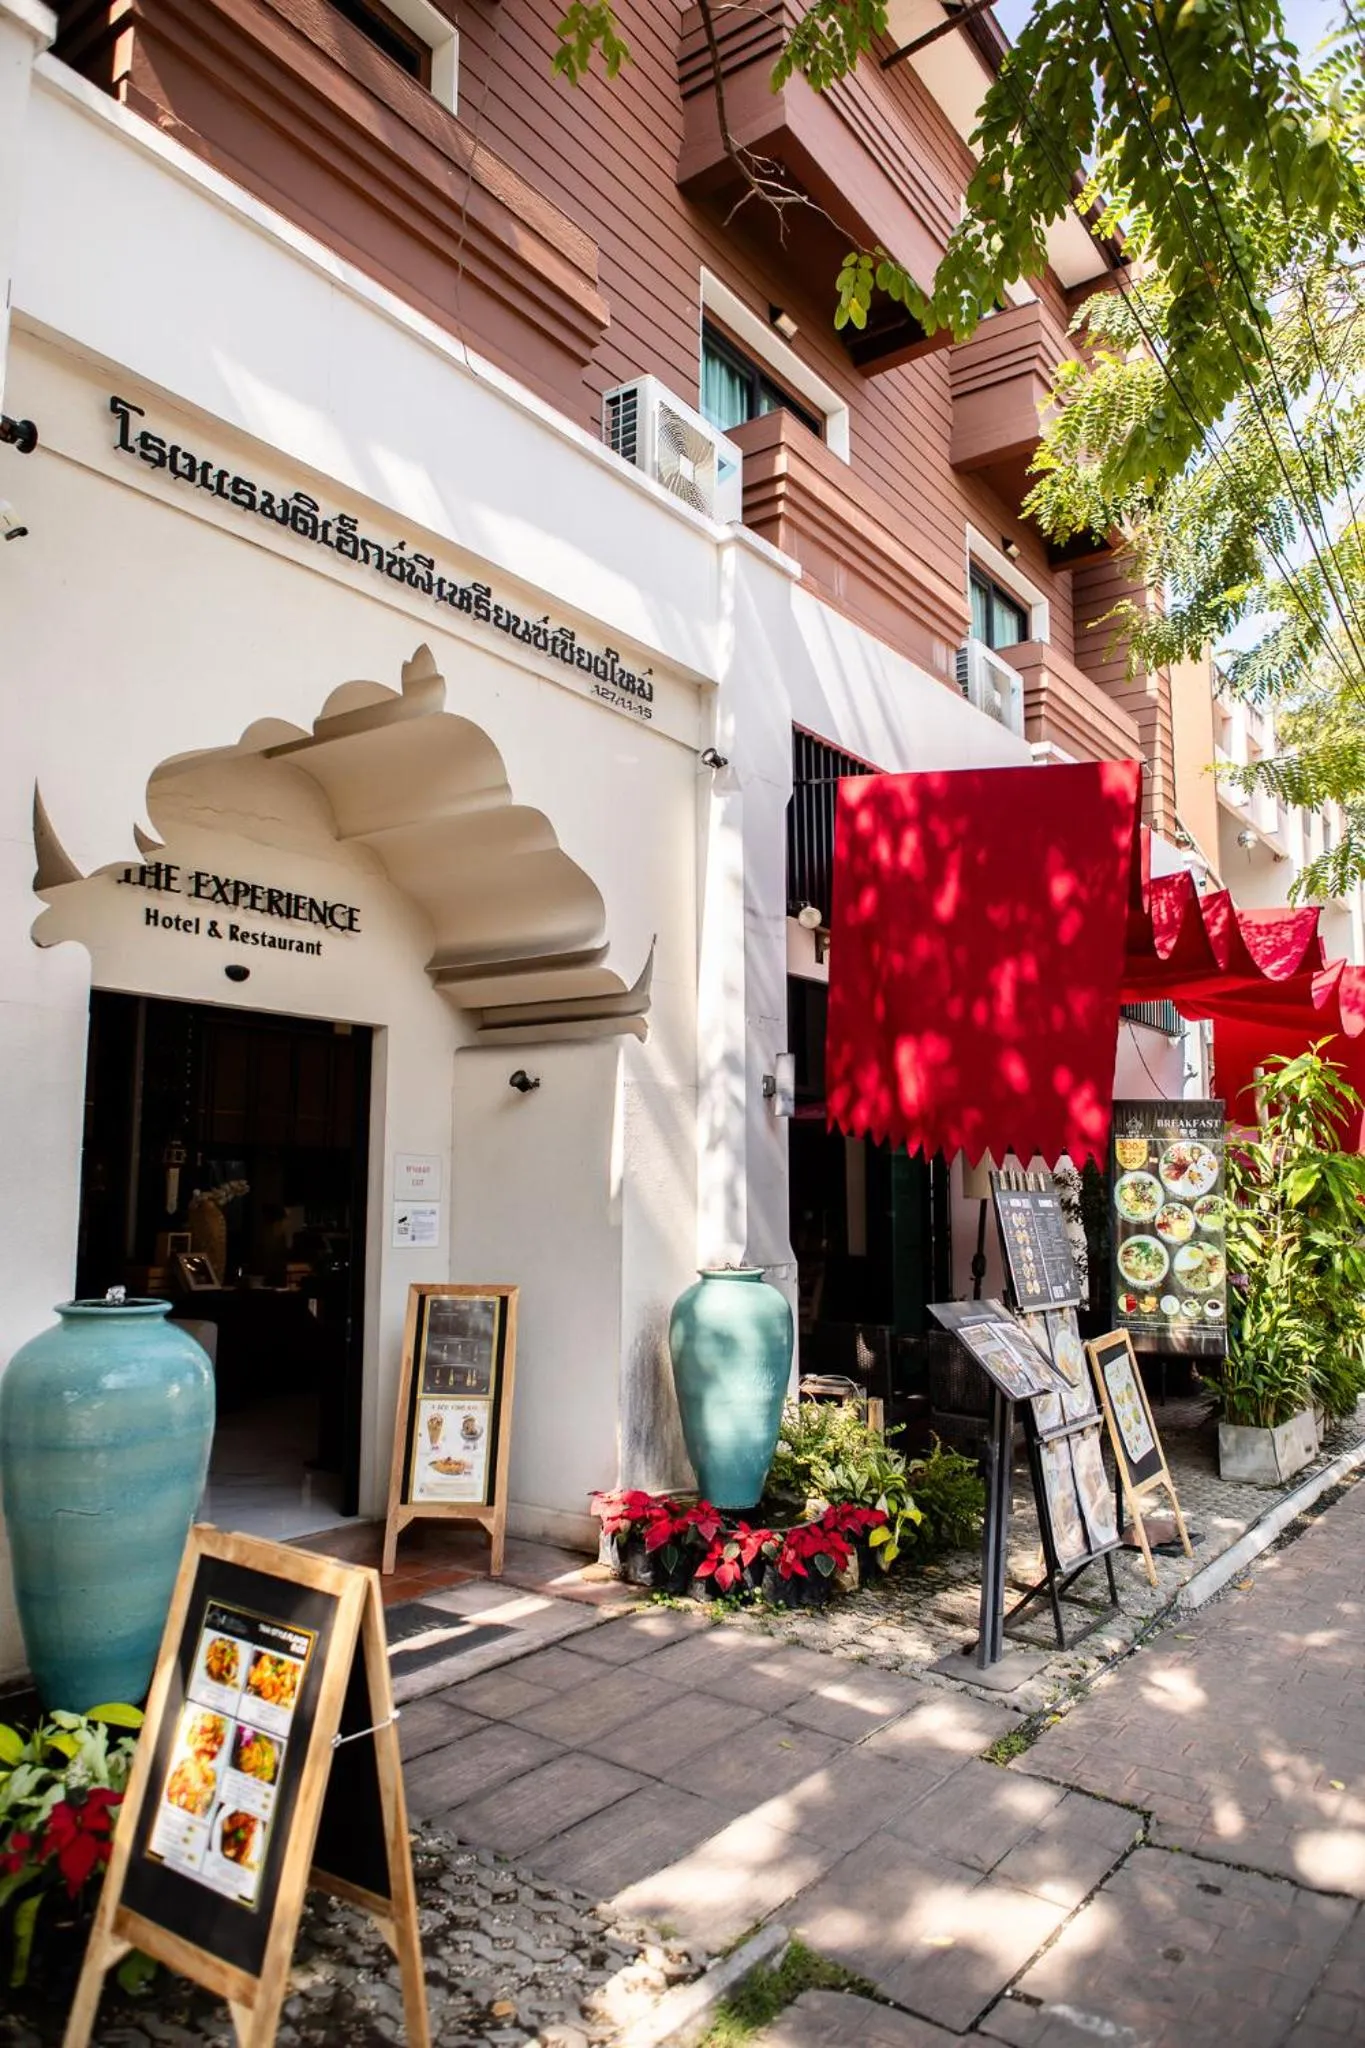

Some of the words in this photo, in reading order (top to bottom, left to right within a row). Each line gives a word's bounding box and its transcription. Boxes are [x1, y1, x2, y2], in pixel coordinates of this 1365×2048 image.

[592, 684, 653, 719] 127/11-15
[189, 870, 362, 933] EXPERIENCE
[145, 907, 200, 934] Hotel
[207, 920, 223, 939] &
[229, 924, 323, 956] Restaurant
[1156, 1119, 1220, 1128] BREAKFAST
